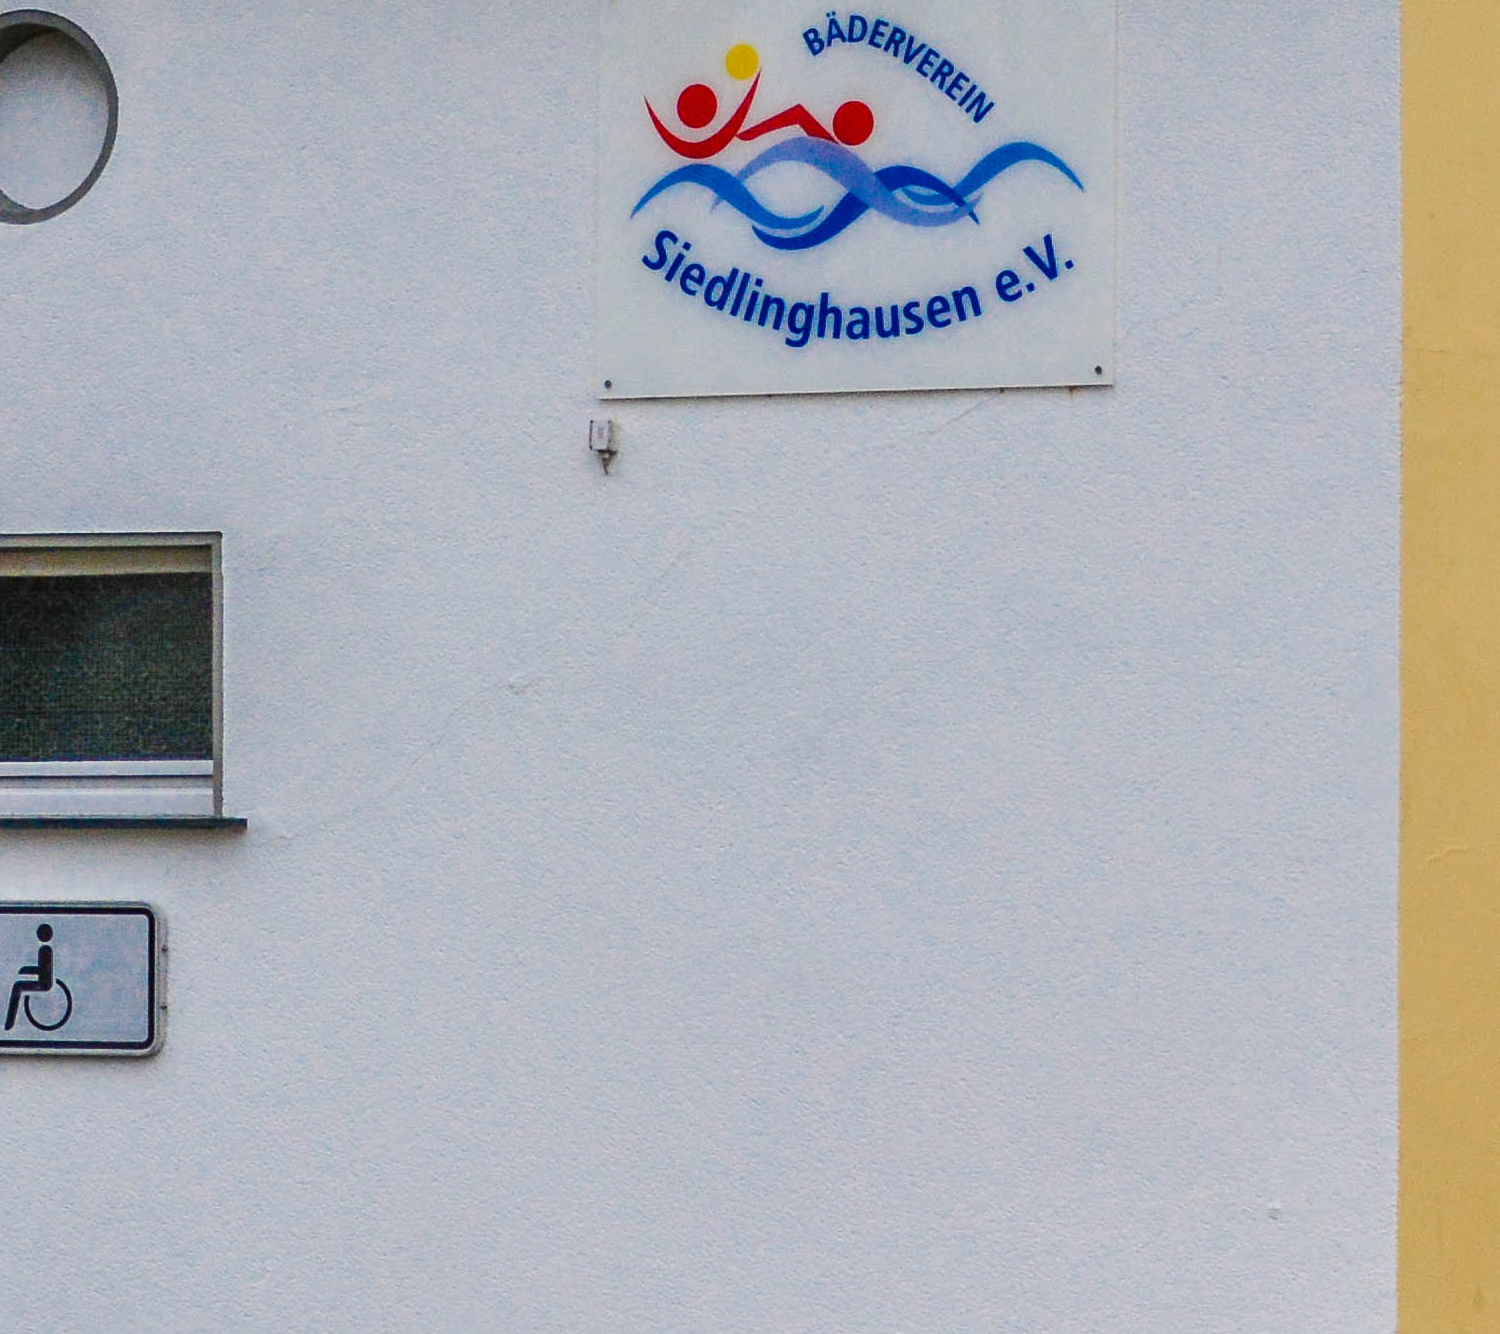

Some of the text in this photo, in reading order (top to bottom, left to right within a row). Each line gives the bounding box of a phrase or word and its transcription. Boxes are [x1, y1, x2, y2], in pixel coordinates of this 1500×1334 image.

[801, 10, 996, 124] BÄDERVEREIN
[641, 229, 1076, 349] Siedlinghausen e.V.
